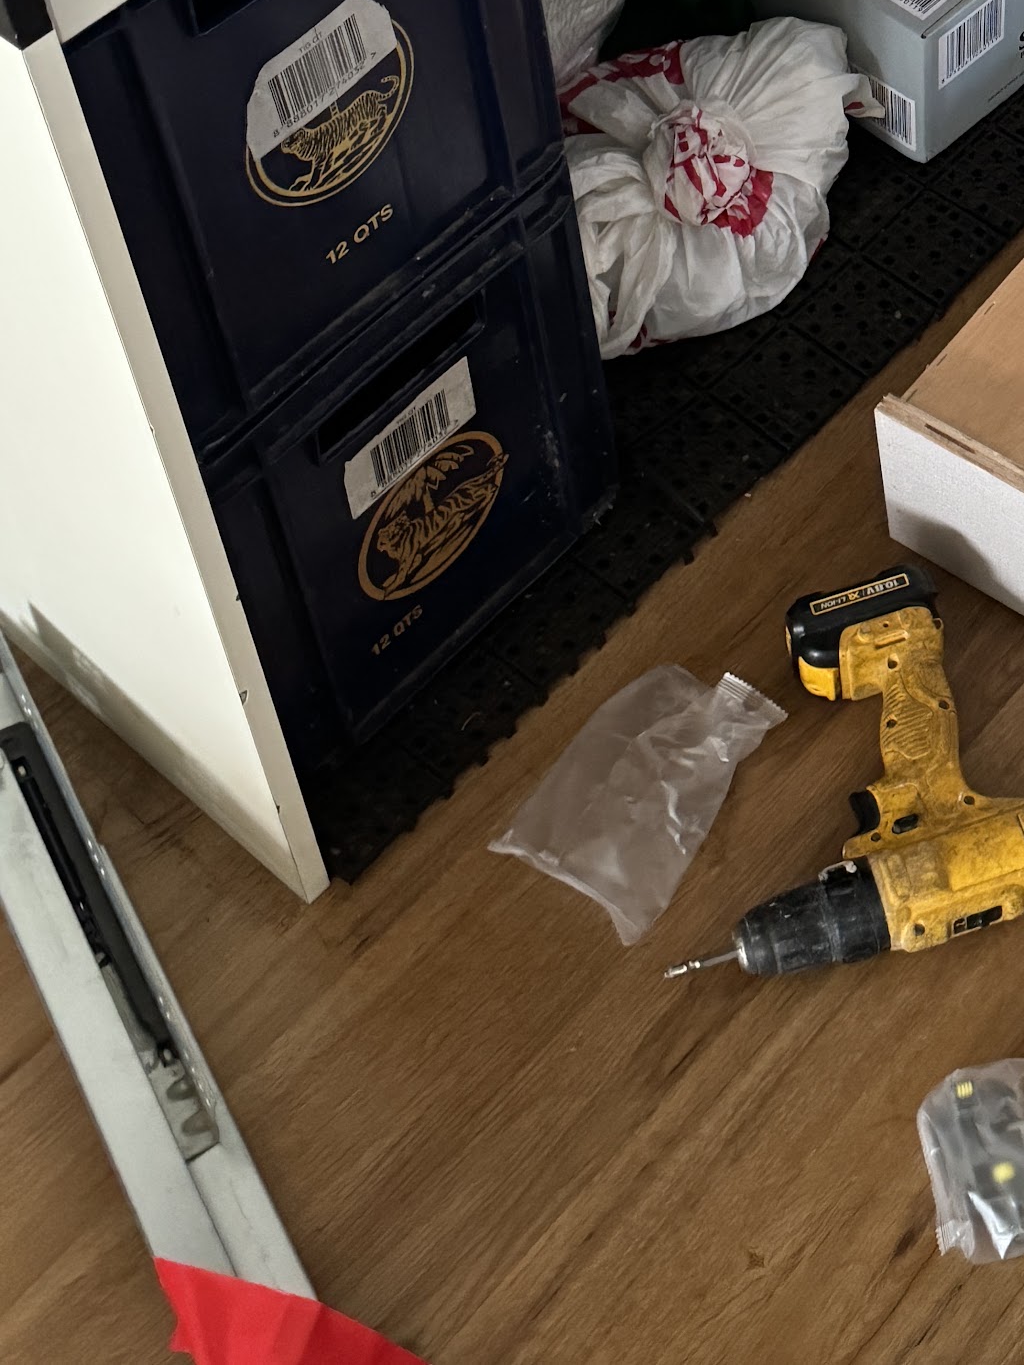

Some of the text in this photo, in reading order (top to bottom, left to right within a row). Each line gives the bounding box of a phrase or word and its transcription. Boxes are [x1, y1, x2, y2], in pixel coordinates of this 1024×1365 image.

[325, 203, 395, 265] 12 QTS
[371, 604, 424, 656] 12 QTS
